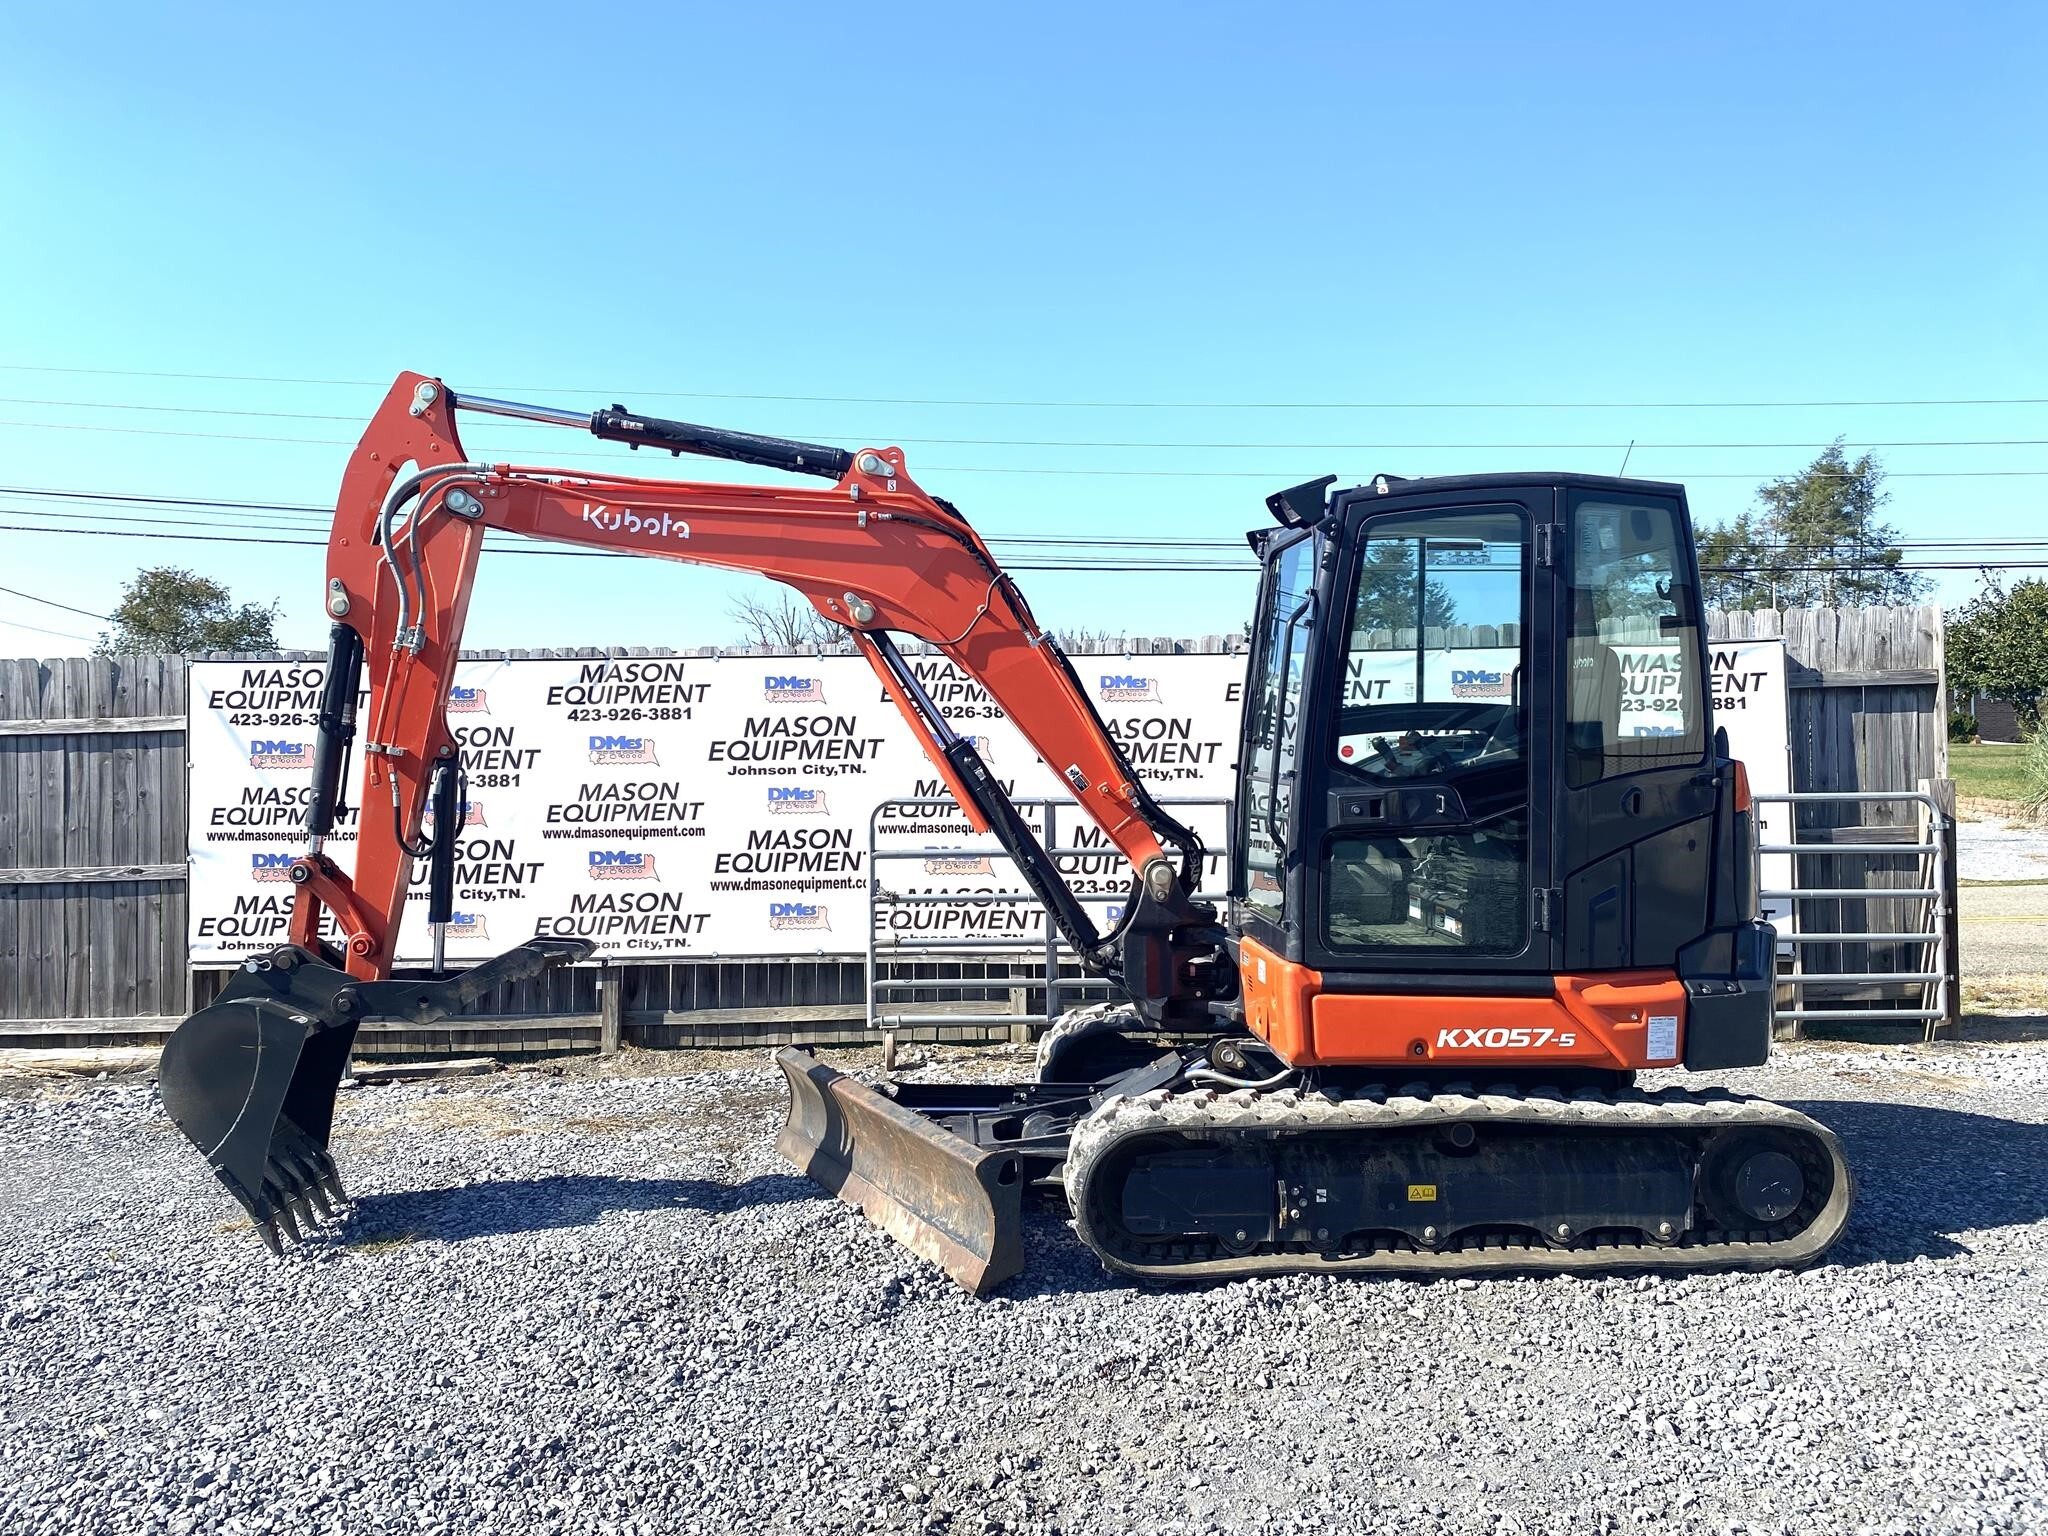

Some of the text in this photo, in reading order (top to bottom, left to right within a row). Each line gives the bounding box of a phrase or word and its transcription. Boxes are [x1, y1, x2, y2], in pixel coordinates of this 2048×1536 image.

[583, 503, 690, 539] Kubota
[241, 669, 324, 688] MASO
[580, 663, 684, 683] MASON
[208, 690, 371, 709] EQUIPMT
[547, 684, 711, 705] EQUIPMENT
[229, 713, 320, 726] 423-926-3
[568, 707, 692, 721] 423-926-3881
[744, 716, 856, 737] MASON
[1105, 718, 1192, 739] ASON
[454, 727, 514, 747] SON
[708, 739, 885, 761] EQUIPMENT
[727, 765, 797, 776] Johnson
[578, 782, 679, 801] MASON
[546, 802, 704, 823] EQUIPMENT
[542, 825, 705, 840] www.dmasonequipment.com
[747, 829, 852, 850] MASON
[714, 851, 867, 873] EQUIPMEN
[570, 892, 683, 914] MASON
[534, 914, 711, 936] EQUIPMENT
[1436, 1028, 1576, 1048] KX057-5
